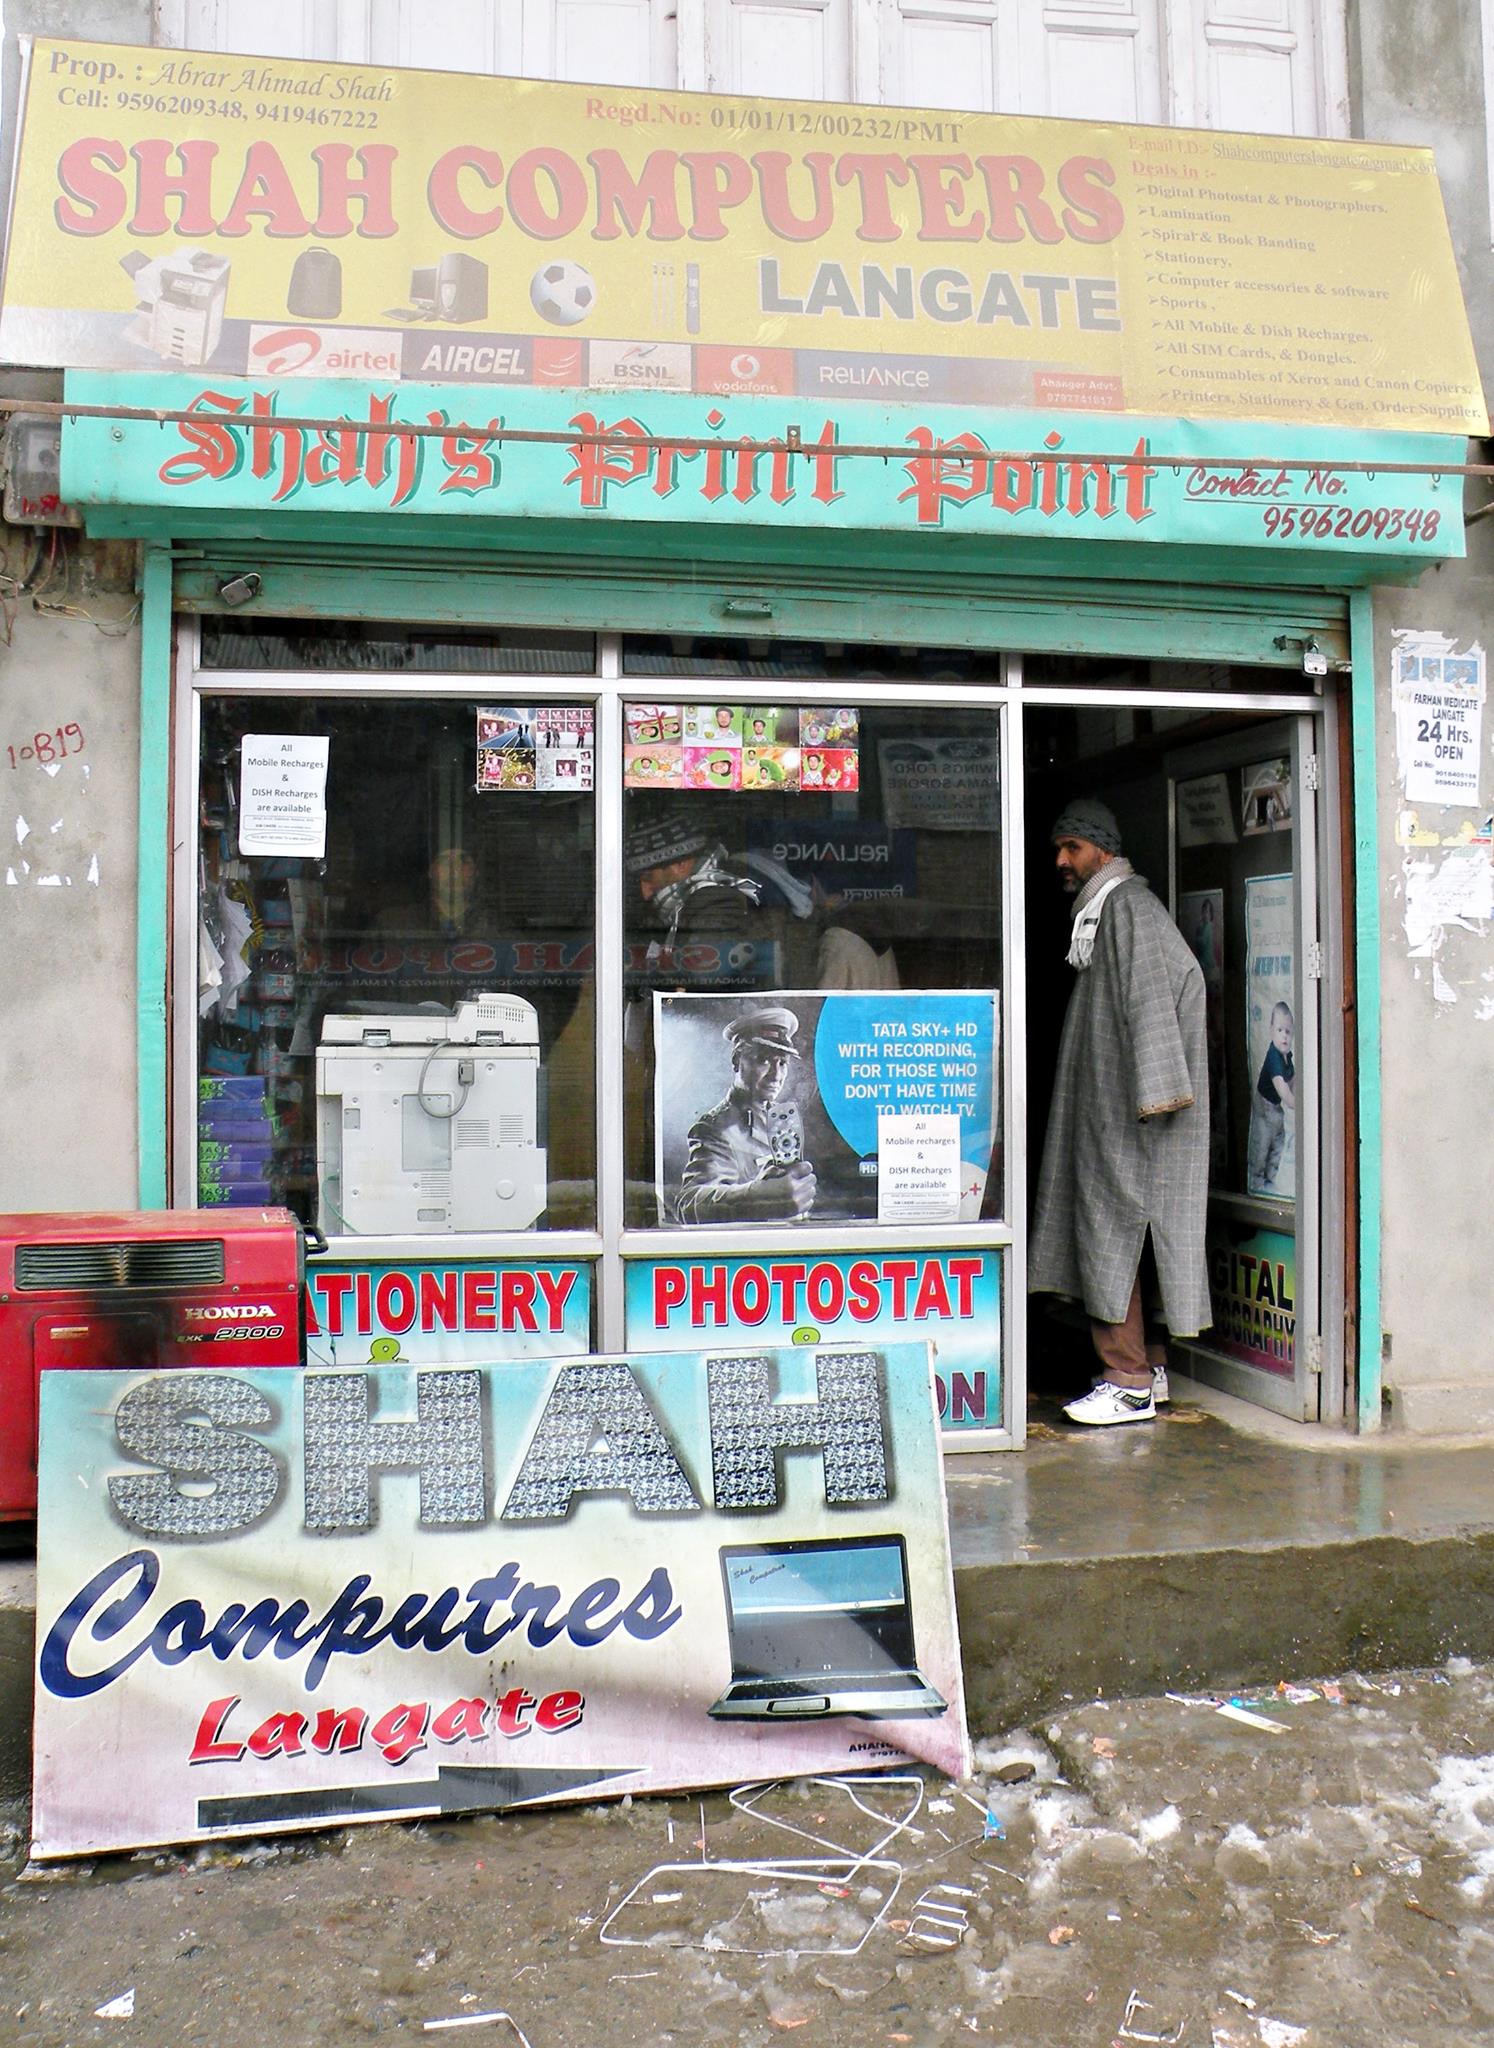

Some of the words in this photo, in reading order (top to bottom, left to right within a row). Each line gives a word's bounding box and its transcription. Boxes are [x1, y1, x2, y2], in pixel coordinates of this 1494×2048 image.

[50, 52, 124, 84] Prop.
[151, 61, 230, 88] Abrar
[231, 68, 330, 98] Ahmad
[329, 76, 393, 102] Shah
[57, 87, 110, 109] Cell:
[117, 91, 249, 122] 9596209348,
[255, 103, 379, 130] 9419467222
[584, 96, 702, 128] Regd.No:
[709, 106, 964, 145] 01/01/12/00232/PMT
[1131, 159, 1180, 179] Deals
[1183, 164, 1200, 178] in
[54, 137, 400, 239] SHAH
[426, 144, 1125, 246] COMPUTERS
[1147, 183, 1195, 200] Digital
[1199, 187, 1263, 205] Photostat
[1267, 194, 1281, 206] &
[1285, 194, 1389, 215] Photographers.
[1150, 206, 1232, 224] Lamination
[1152, 227, 1197, 243] Spiral
[1200, 231, 1214, 243] &
[1217, 233, 1254, 246] Book
[1257, 234, 1317, 252] Banding
[758, 256, 1123, 333] LANGATE
[1158, 272, 1231, 291] Computer
[1234, 279, 1312, 295] accessories
[1314, 283, 1328, 296] &
[1331, 285, 1391, 300] software
[1160, 295, 1208, 312] Sports
[1164, 318, 1185, 331] All
[1189, 320, 1239, 335] Mobile
[1243, 323, 1257, 336] &
[1261, 325, 1293, 338] Dish
[326, 348, 398, 372] airtel
[420, 343, 526, 376] AIRCEL
[1166, 342, 1188, 355] All
[1191, 343, 1223, 357] SIM
[1279, 348, 1293, 361] &
[614, 363, 676, 380] BSNL
[1168, 365, 1266, 383] Consumables
[1269, 371, 1284, 384] of
[1288, 372, 1330, 387] Xerox
[1334, 376, 1360, 389] and
[1364, 376, 1411, 391] Canon
[1238, 392, 1314, 410] Stationery
[1317, 396, 1331, 410] &
[1372, 398, 1416, 414] Order
[157, 388, 505, 508] Shah's
[563, 406, 848, 510] Print
[896, 425, 1159, 529] Point
[1185, 466, 1294, 498] Contact
[1304, 468, 1349, 496] No.
[1262, 505, 1442, 544] 9596209348
[1414, 692, 1443, 707] FARHAN
[1432, 707, 1465, 722] LANGATE
[1417, 719, 1443, 743] 24
[1447, 724, 1474, 744] Hrs.
[281, 744, 293, 752] All
[1435, 744, 1464, 760] OPEN
[248, 757, 279, 767] Mobile
[280, 759, 325, 770] Recharges
[281, 774, 289, 782] &
[252, 788, 273, 797] DISH
[274, 788, 319, 800] Recharges
[257, 804, 272, 812] are
[273, 804, 312, 814] available
[871, 1022, 908, 1037] TATA
[911, 1022, 951, 1037] SKY+
[955, 1022, 978, 1037] HD
[838, 1043, 878, 1058] WITH
[883, 1043, 977, 1059] RECORDING,
[851, 1063, 882, 1078] FOR
[886, 1063, 938, 1078] THOSE
[941, 1062, 978, 1077] WHO
[844, 1083, 892, 1099] DON'T
[896, 1083, 936, 1098] HAVE
[940, 1083, 977, 1098] TIME
[875, 1104, 895, 1116] TO
[900, 1103, 951, 1116] WATCH
[955, 1103, 976, 1117] TV.
[915, 1122, 927, 1130] All
[885, 1138, 914, 1146] Mobile
[916, 1137, 956, 1147] recharges
[917, 1151, 924, 1160] &
[861, 1164, 878, 1175] HD
[889, 1166, 909, 1175] DISH
[911, 1165, 952, 1176] Recharges
[894, 1181, 909, 1190] are
[910, 1180, 947, 1190] available
[651, 1257, 983, 1329] PHOTOSTAT
[184, 1304, 278, 1321] HONDA
[213, 1324, 286, 1342] 2800
[106, 1351, 892, 1537] SHAH
[38, 1546, 685, 1700] Computres
[186, 1684, 586, 1769] Langate
